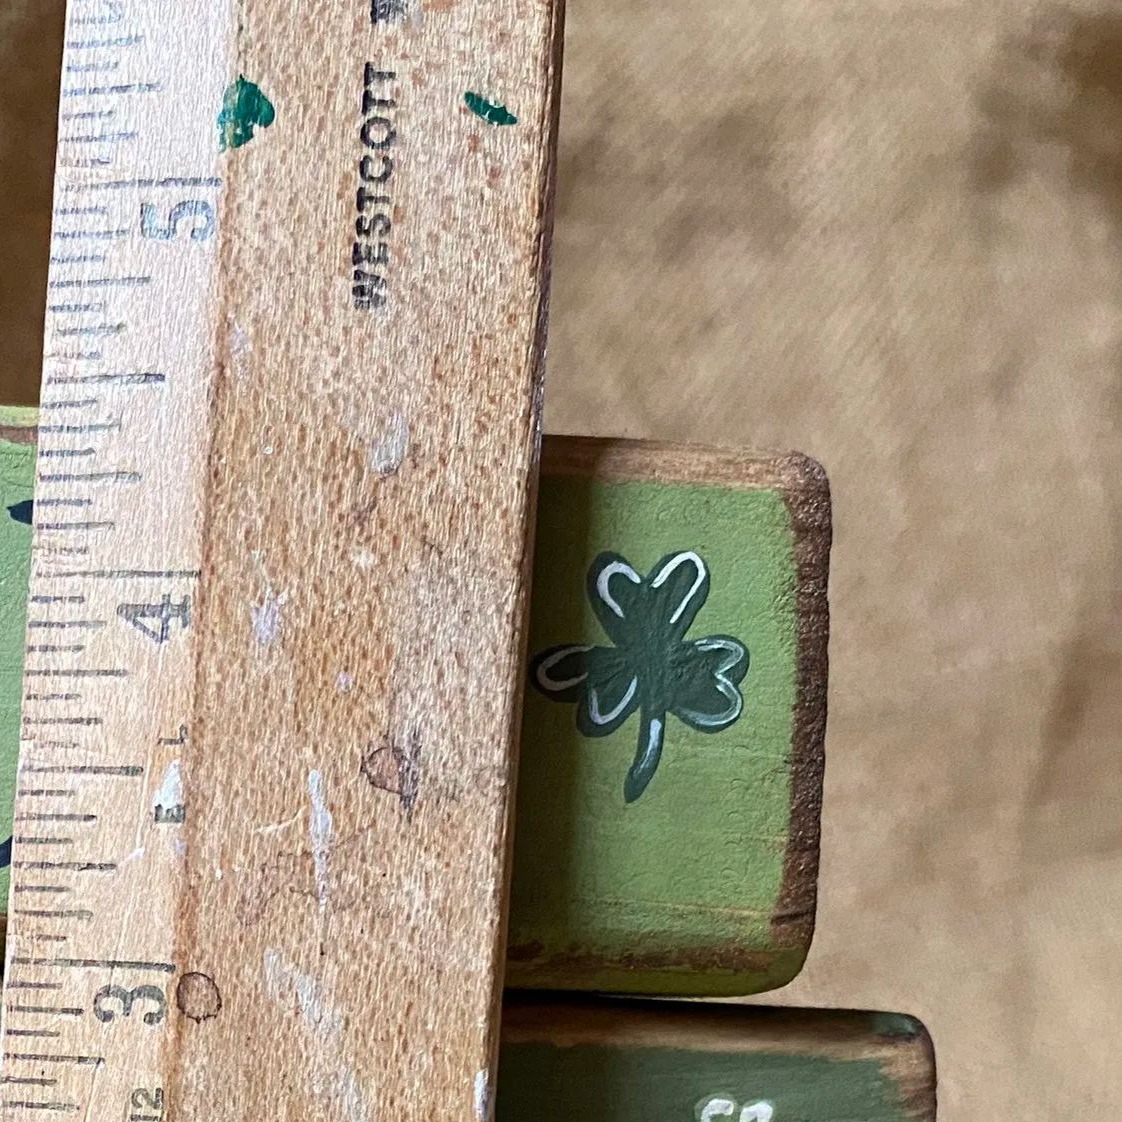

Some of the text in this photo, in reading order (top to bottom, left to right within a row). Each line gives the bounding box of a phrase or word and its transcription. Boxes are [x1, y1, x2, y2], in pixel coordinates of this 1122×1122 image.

[352, 61, 397, 311] WESTCOTT
[140, 198, 216, 241] 5
[116, 594, 191, 644] 4
[93, 984, 165, 1026] 3
